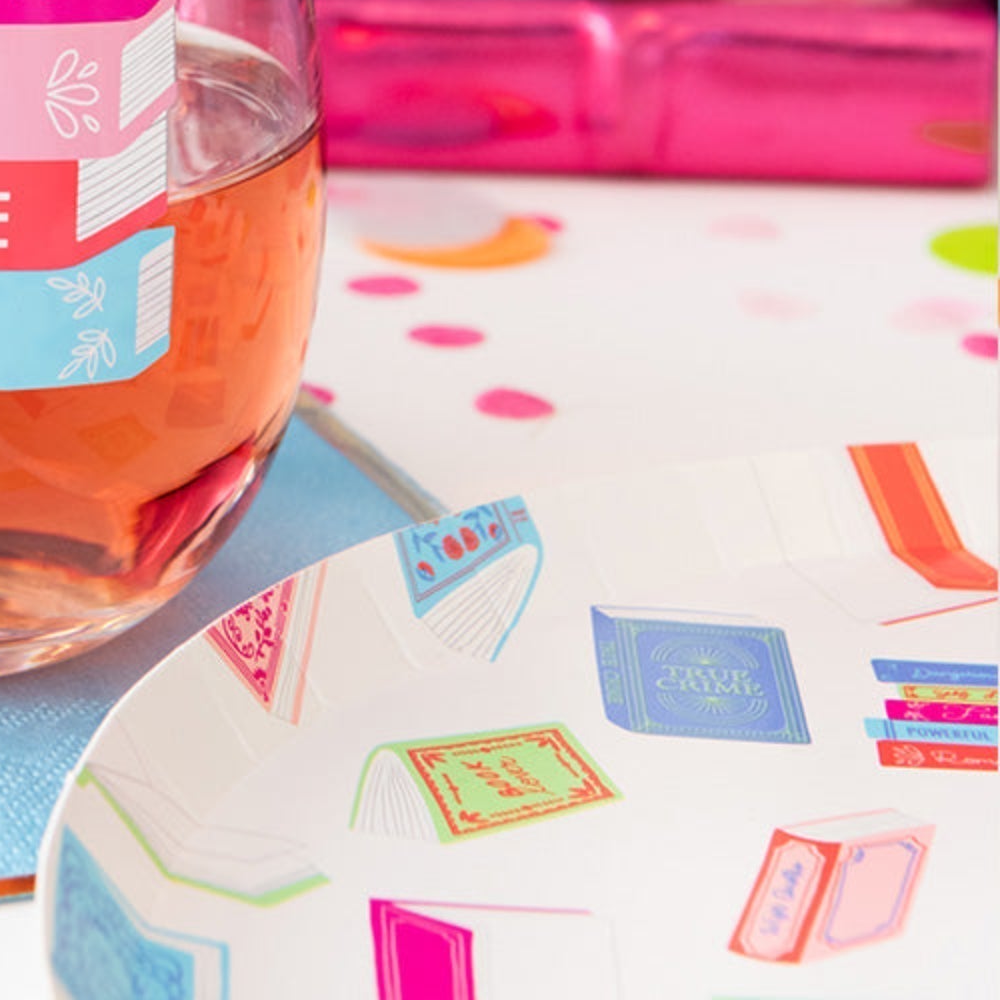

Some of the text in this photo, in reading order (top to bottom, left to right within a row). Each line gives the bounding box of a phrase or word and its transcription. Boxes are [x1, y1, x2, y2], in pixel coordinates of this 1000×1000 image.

[662, 665, 751, 682] TRUE
[656, 678, 765, 697] CRIME
[906, 726, 993, 742] POWERFUL
